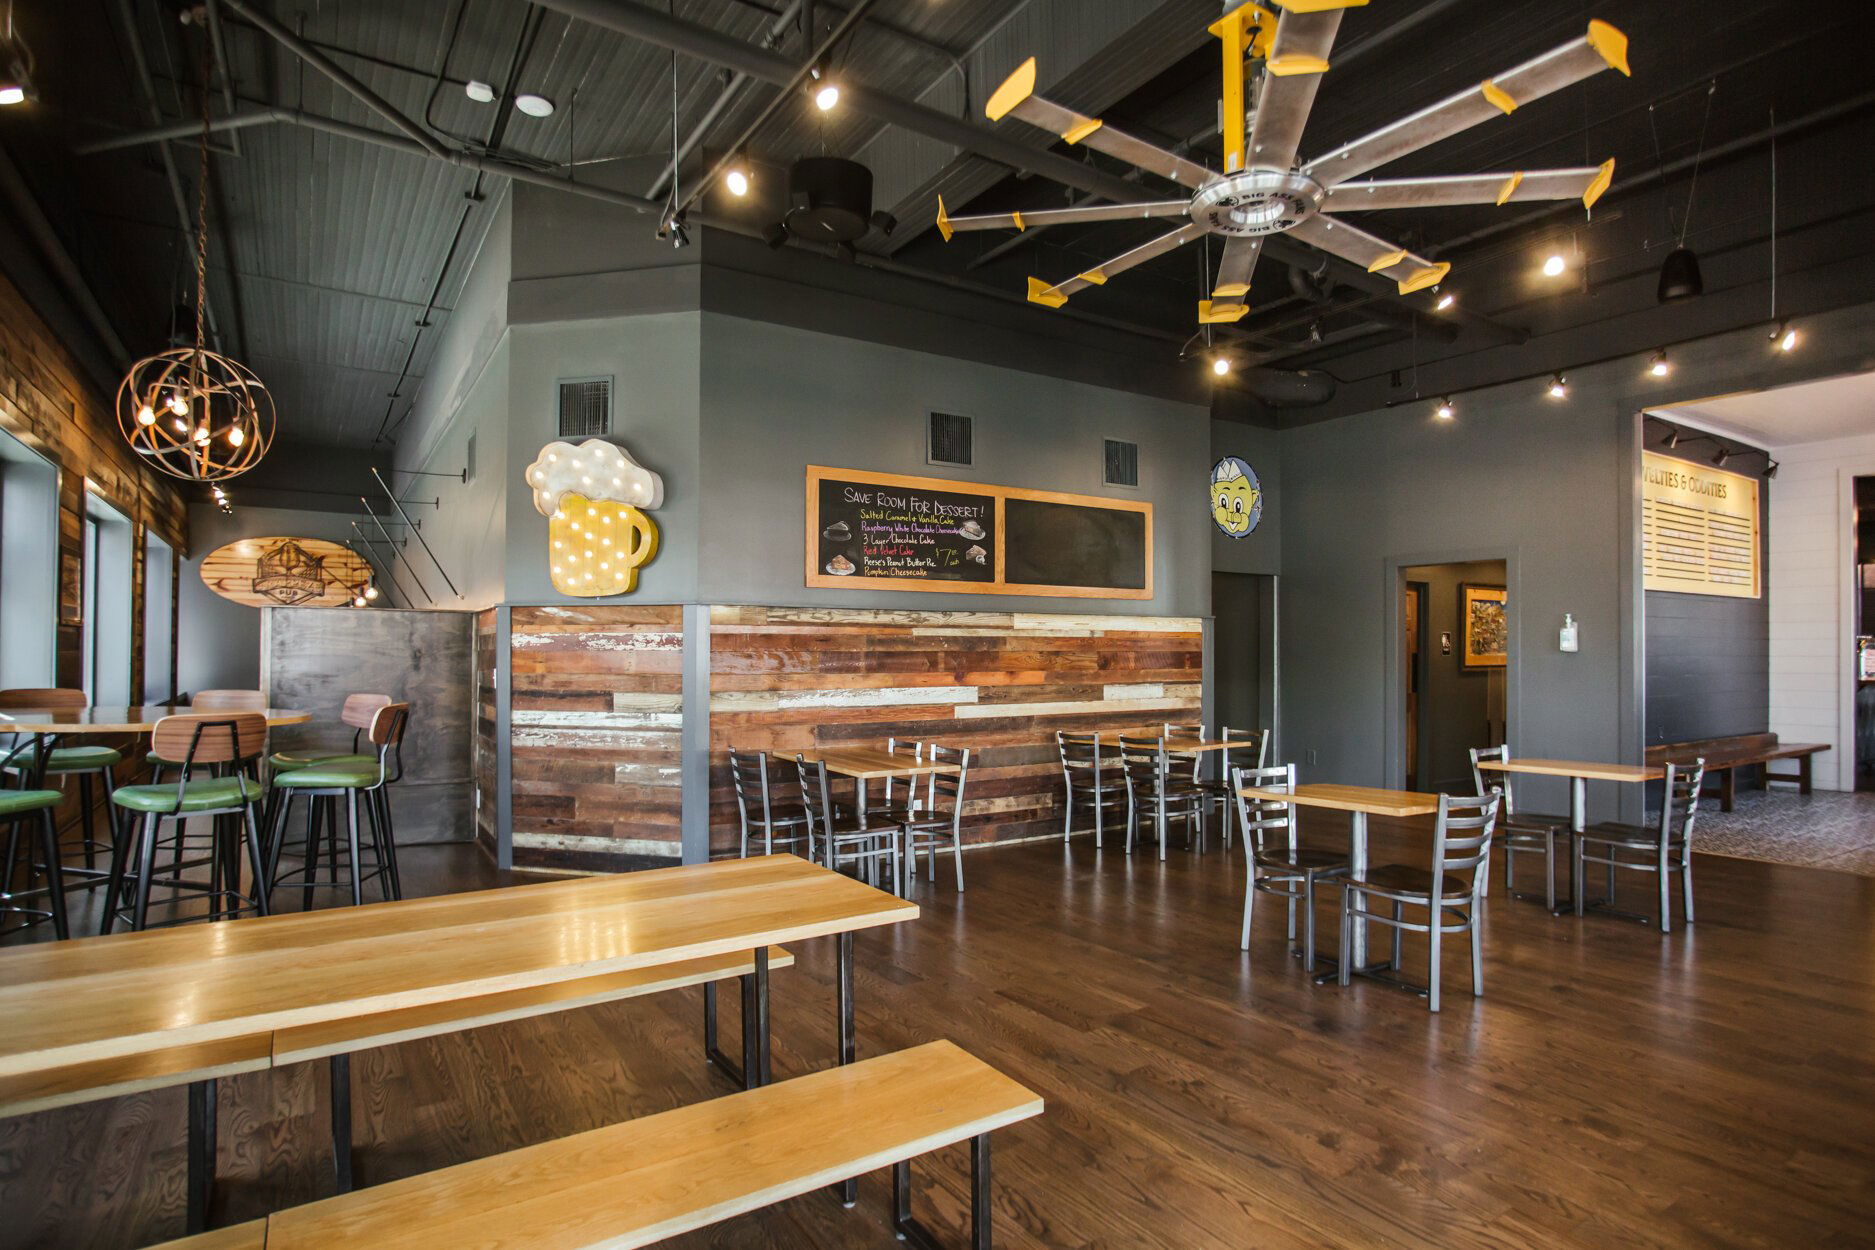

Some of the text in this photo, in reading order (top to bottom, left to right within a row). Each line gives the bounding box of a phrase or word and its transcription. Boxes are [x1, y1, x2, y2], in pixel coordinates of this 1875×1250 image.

[1242, 192, 1265, 200] BIG
[1269, 192, 1294, 201] ASS
[1681, 474, 1687, 490] &
[1689, 476, 1727, 499] ODDITIES
[844, 487, 873, 504] SAVE
[877, 492, 906, 510] ROOM
[910, 496, 930, 514] FOR
[860, 509, 884, 520] Salted
[885, 511, 911, 522] Caramel
[918, 513, 939, 525] Vanilla
[939, 515, 954, 525] Cake
[861, 520, 893, 535] Raspberry
[911, 522, 935, 534] Chocolate
[863, 533, 936, 549] 3 Layer Chocolate Cake
[864, 556, 886, 567] Reese's
[886, 557, 905, 567] Peanut
[906, 557, 926, 567] Butter
[864, 567, 928, 578] Pumpkin Cheesecake
[279, 589, 298, 597] PUB
